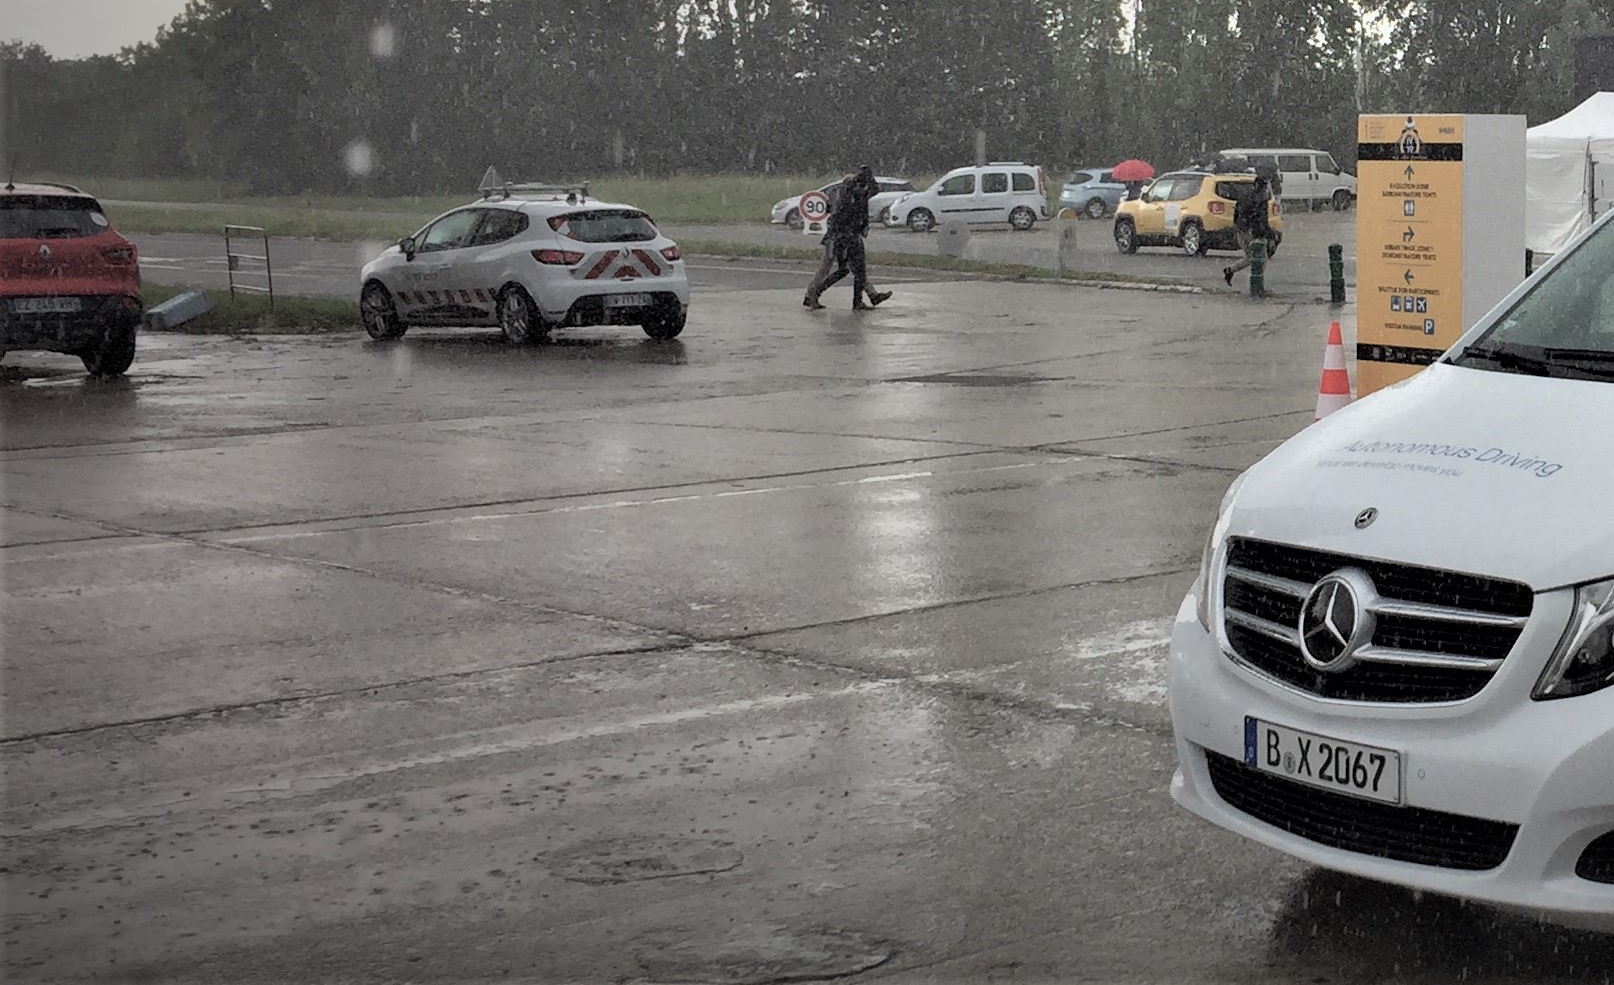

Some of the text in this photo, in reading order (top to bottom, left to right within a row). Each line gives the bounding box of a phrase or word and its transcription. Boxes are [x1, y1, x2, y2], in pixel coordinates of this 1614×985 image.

[806, 201, 825, 213] 90
[1336, 440, 1563, 477] Autonomous Driving
[1267, 729, 1386, 791] B X 2067
